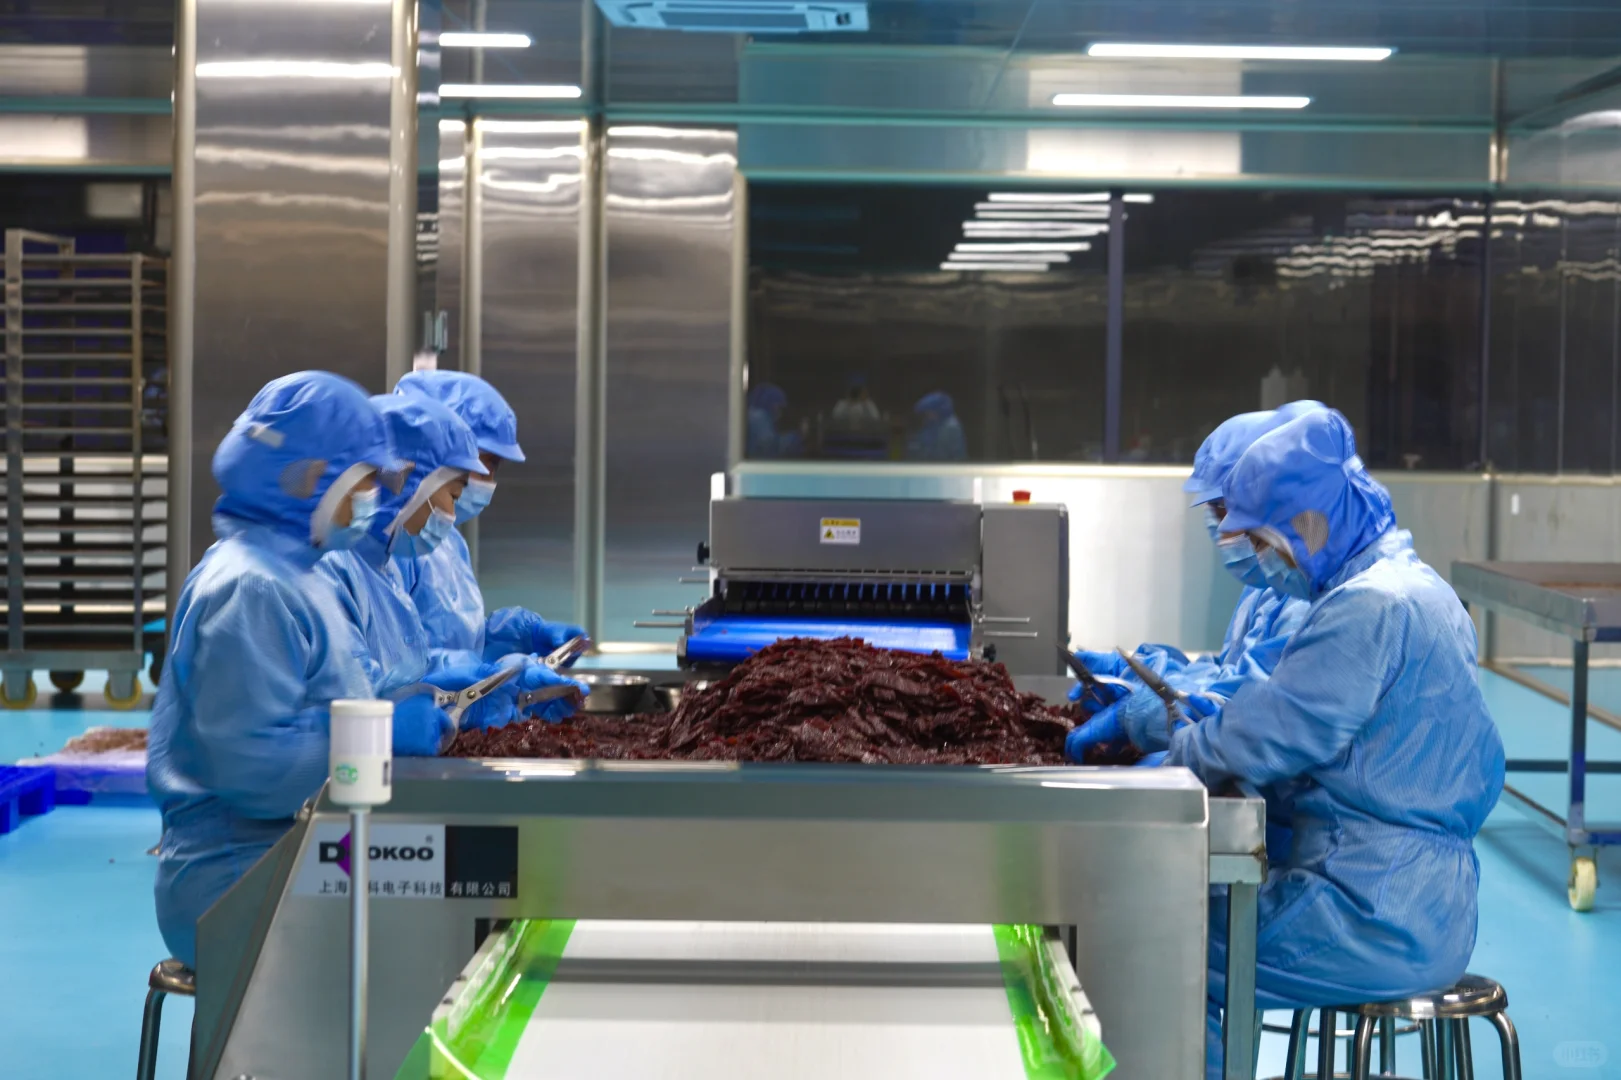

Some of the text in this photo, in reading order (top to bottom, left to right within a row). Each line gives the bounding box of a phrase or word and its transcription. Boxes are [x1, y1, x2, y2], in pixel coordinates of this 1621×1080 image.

[319, 842, 434, 863] DOKOO
[318, 880, 511, 896] 上海科电子科技有限公司
